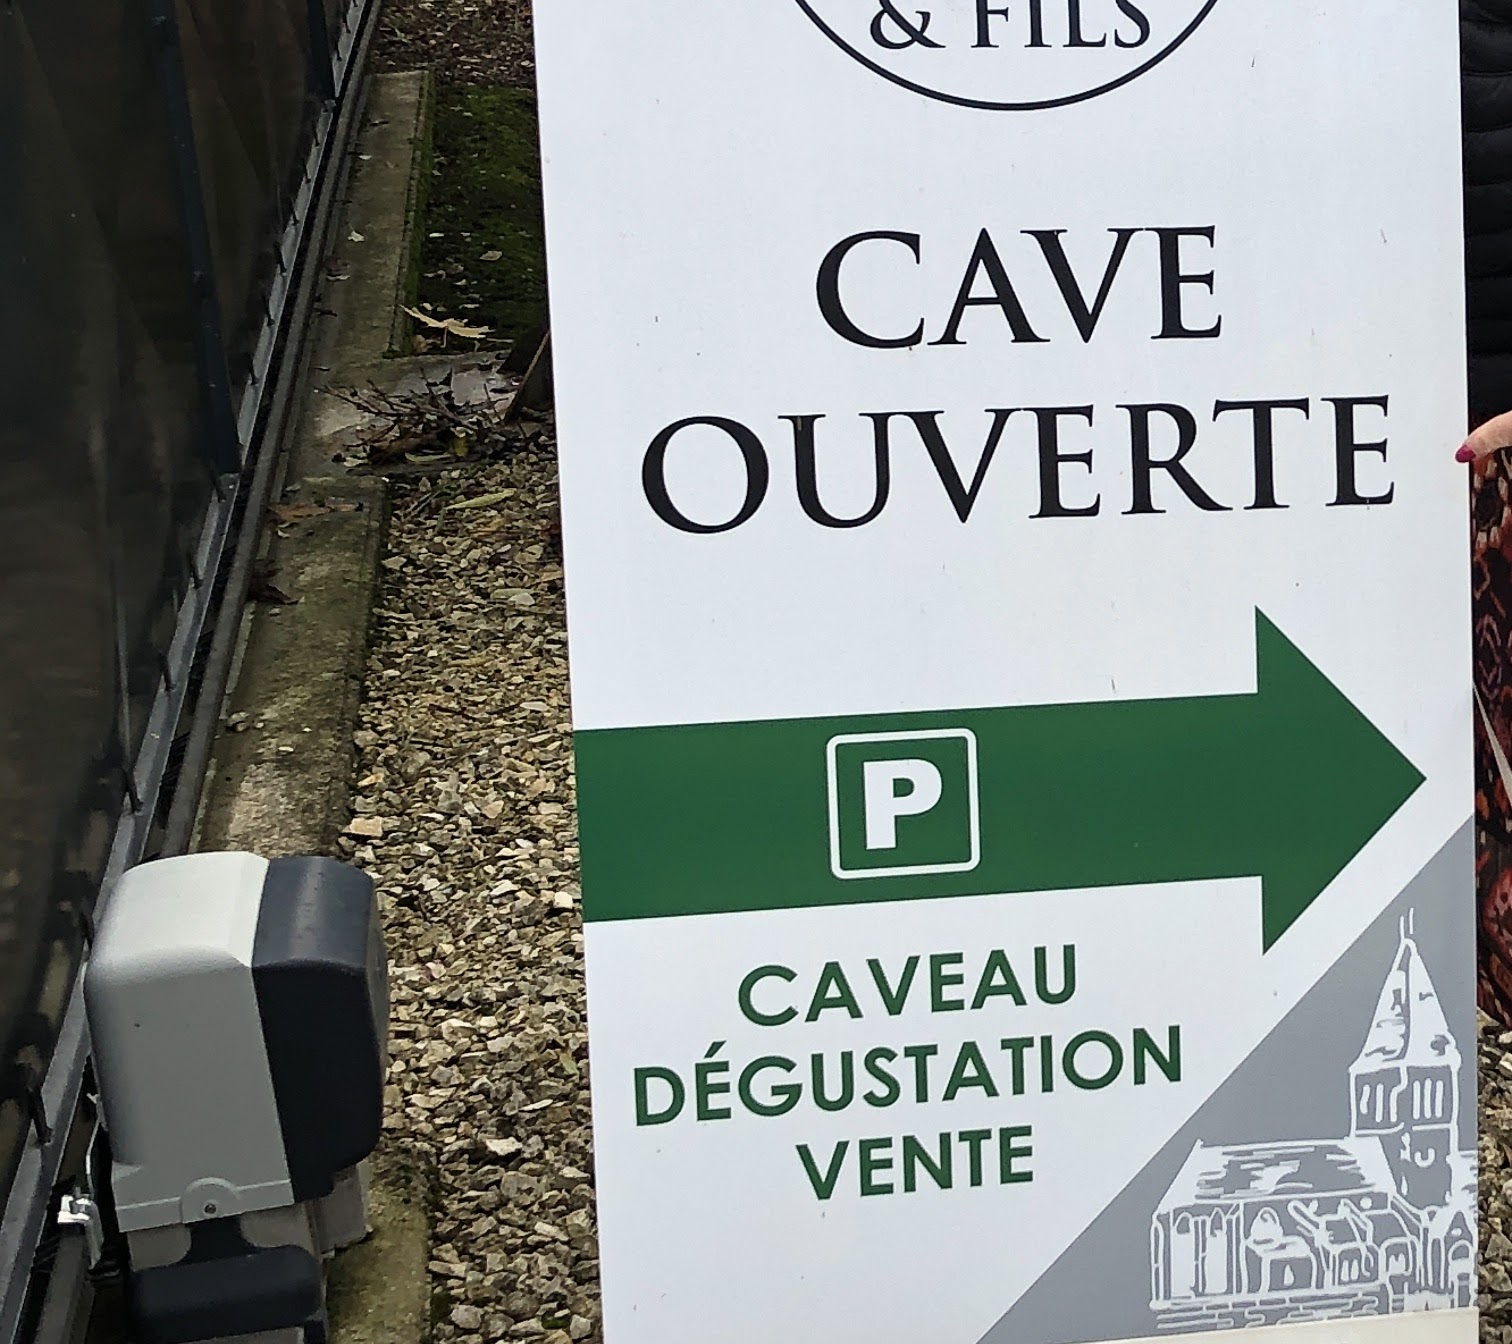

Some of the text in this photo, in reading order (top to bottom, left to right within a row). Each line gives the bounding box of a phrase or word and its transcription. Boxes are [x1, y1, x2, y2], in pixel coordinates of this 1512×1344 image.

[816, 225, 1221, 350] CAVE
[642, 395, 1394, 534] OUVERTE
[864, 759, 941, 849] P
[739, 944, 1075, 1026] CAVEAU
[635, 1025, 1182, 1126] DÉGUSTATION
[796, 1126, 1033, 1200] VENTE
